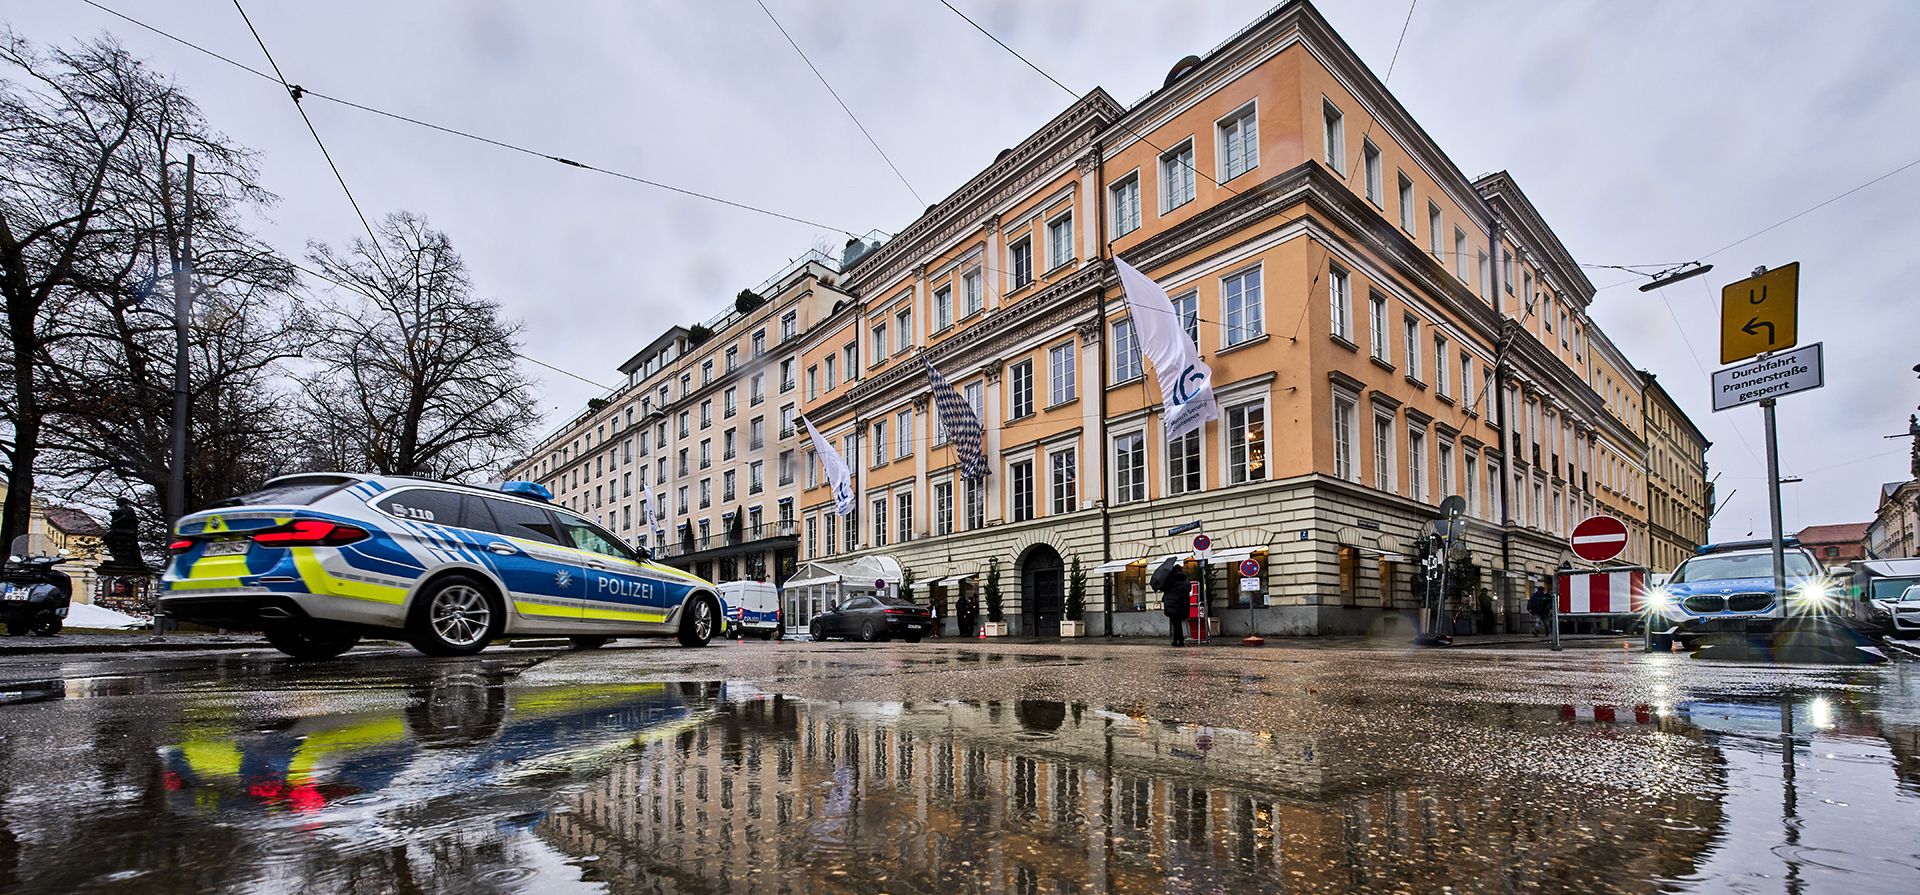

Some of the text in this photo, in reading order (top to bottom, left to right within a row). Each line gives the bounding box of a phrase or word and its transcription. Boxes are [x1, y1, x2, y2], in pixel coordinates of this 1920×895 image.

[1749, 284, 1767, 305] U
[1723, 365, 1808, 393] Prannerstraße
[1731, 355, 1797, 380] Durchfahrt
[1739, 381, 1790, 402] gesperrt
[598, 576, 653, 600] POLIZEI
